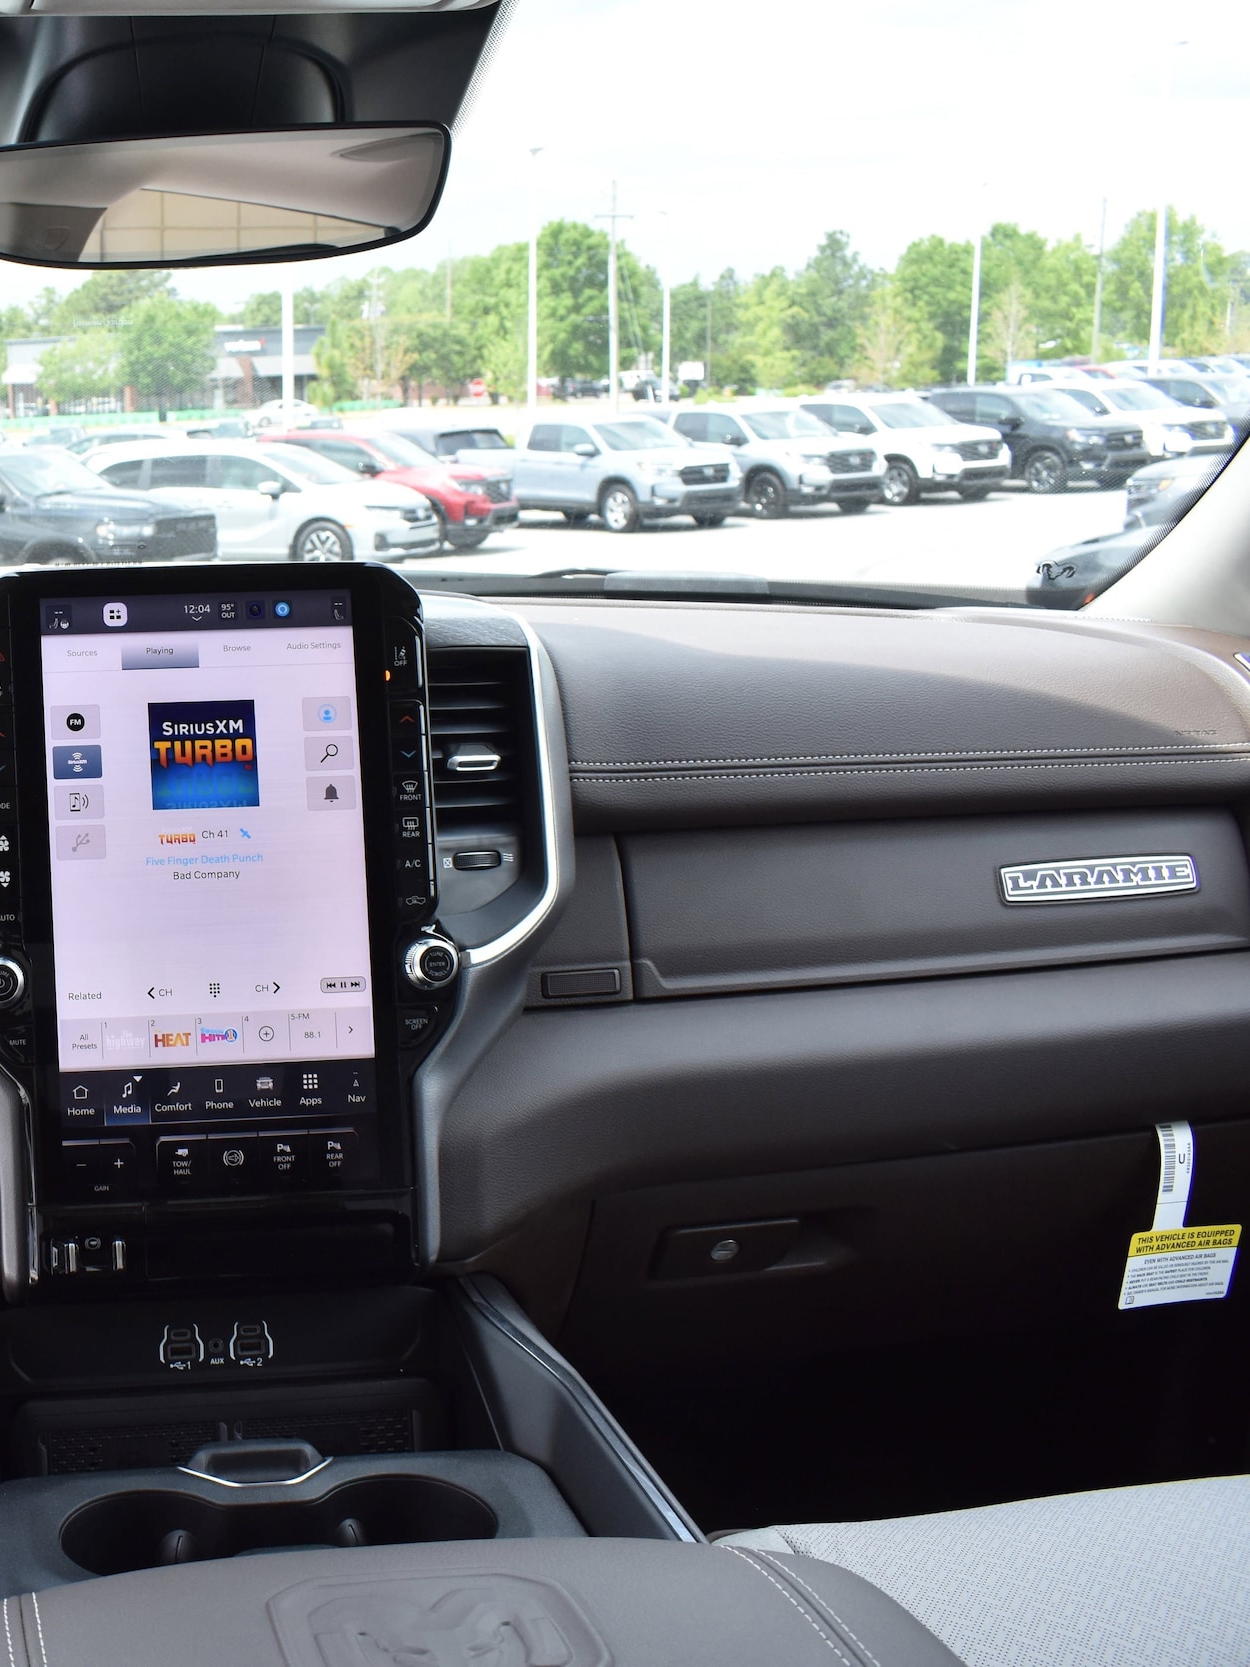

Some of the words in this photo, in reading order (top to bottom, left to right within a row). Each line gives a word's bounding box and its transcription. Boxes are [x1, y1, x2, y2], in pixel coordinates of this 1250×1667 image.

[183, 604, 211, 614] 12:04
[286, 642, 309, 650] Audio
[310, 641, 341, 651] Settings
[67, 649, 98, 657] Sources
[146, 647, 174, 655] Playing
[153, 738, 254, 769] TURBO
[158, 833, 196, 845] TURBO
[201, 830, 215, 839] Ch
[217, 830, 229, 838] 41
[145, 857, 165, 866] Five
[167, 856, 198, 867] Finger
[201, 855, 230, 864] Death
[232, 853, 264, 863] Punch
[405, 859, 421, 868] A/C
[173, 871, 191, 880] Bad
[194, 870, 240, 880] Company
[1007, 862, 1192, 893] LARAMIE
[255, 984, 269, 992] CH
[68, 992, 102, 1000] Related
[158, 989, 173, 997] CH
[304, 1031, 321, 1039] 88.1
[9, 1038, 27, 1047] MUTE
[154, 1032, 191, 1048] HEAT
[249, 1098, 282, 1107] Vehicle
[300, 1097, 322, 1106] Apps
[347, 1094, 366, 1102] Nav
[113, 1105, 142, 1114] Media
[154, 1102, 192, 1112] Comfort
[205, 1101, 234, 1109] Phone
[67, 1107, 95, 1116] Home
[274, 1155, 295, 1163] FRONT
[173, 1160, 191, 1168] TOW/
[1138, 1235, 1154, 1245] THIS
[1155, 1232, 1186, 1242] VEHICLE
[1196, 1229, 1235, 1239] EQUIPPED
[1136, 1245, 1154, 1254] WITH
[1155, 1241, 1196, 1252] ADVANCED
[1197, 1239, 1211, 1247] AIR
[1212, 1238, 1233, 1246] BAGS
[1144, 1257, 1156, 1265] EVEN
[1169, 1254, 1194, 1262] ADVANCED
[210, 1357, 224, 1365] AUX
[257, 1358, 263, 1366] 2
